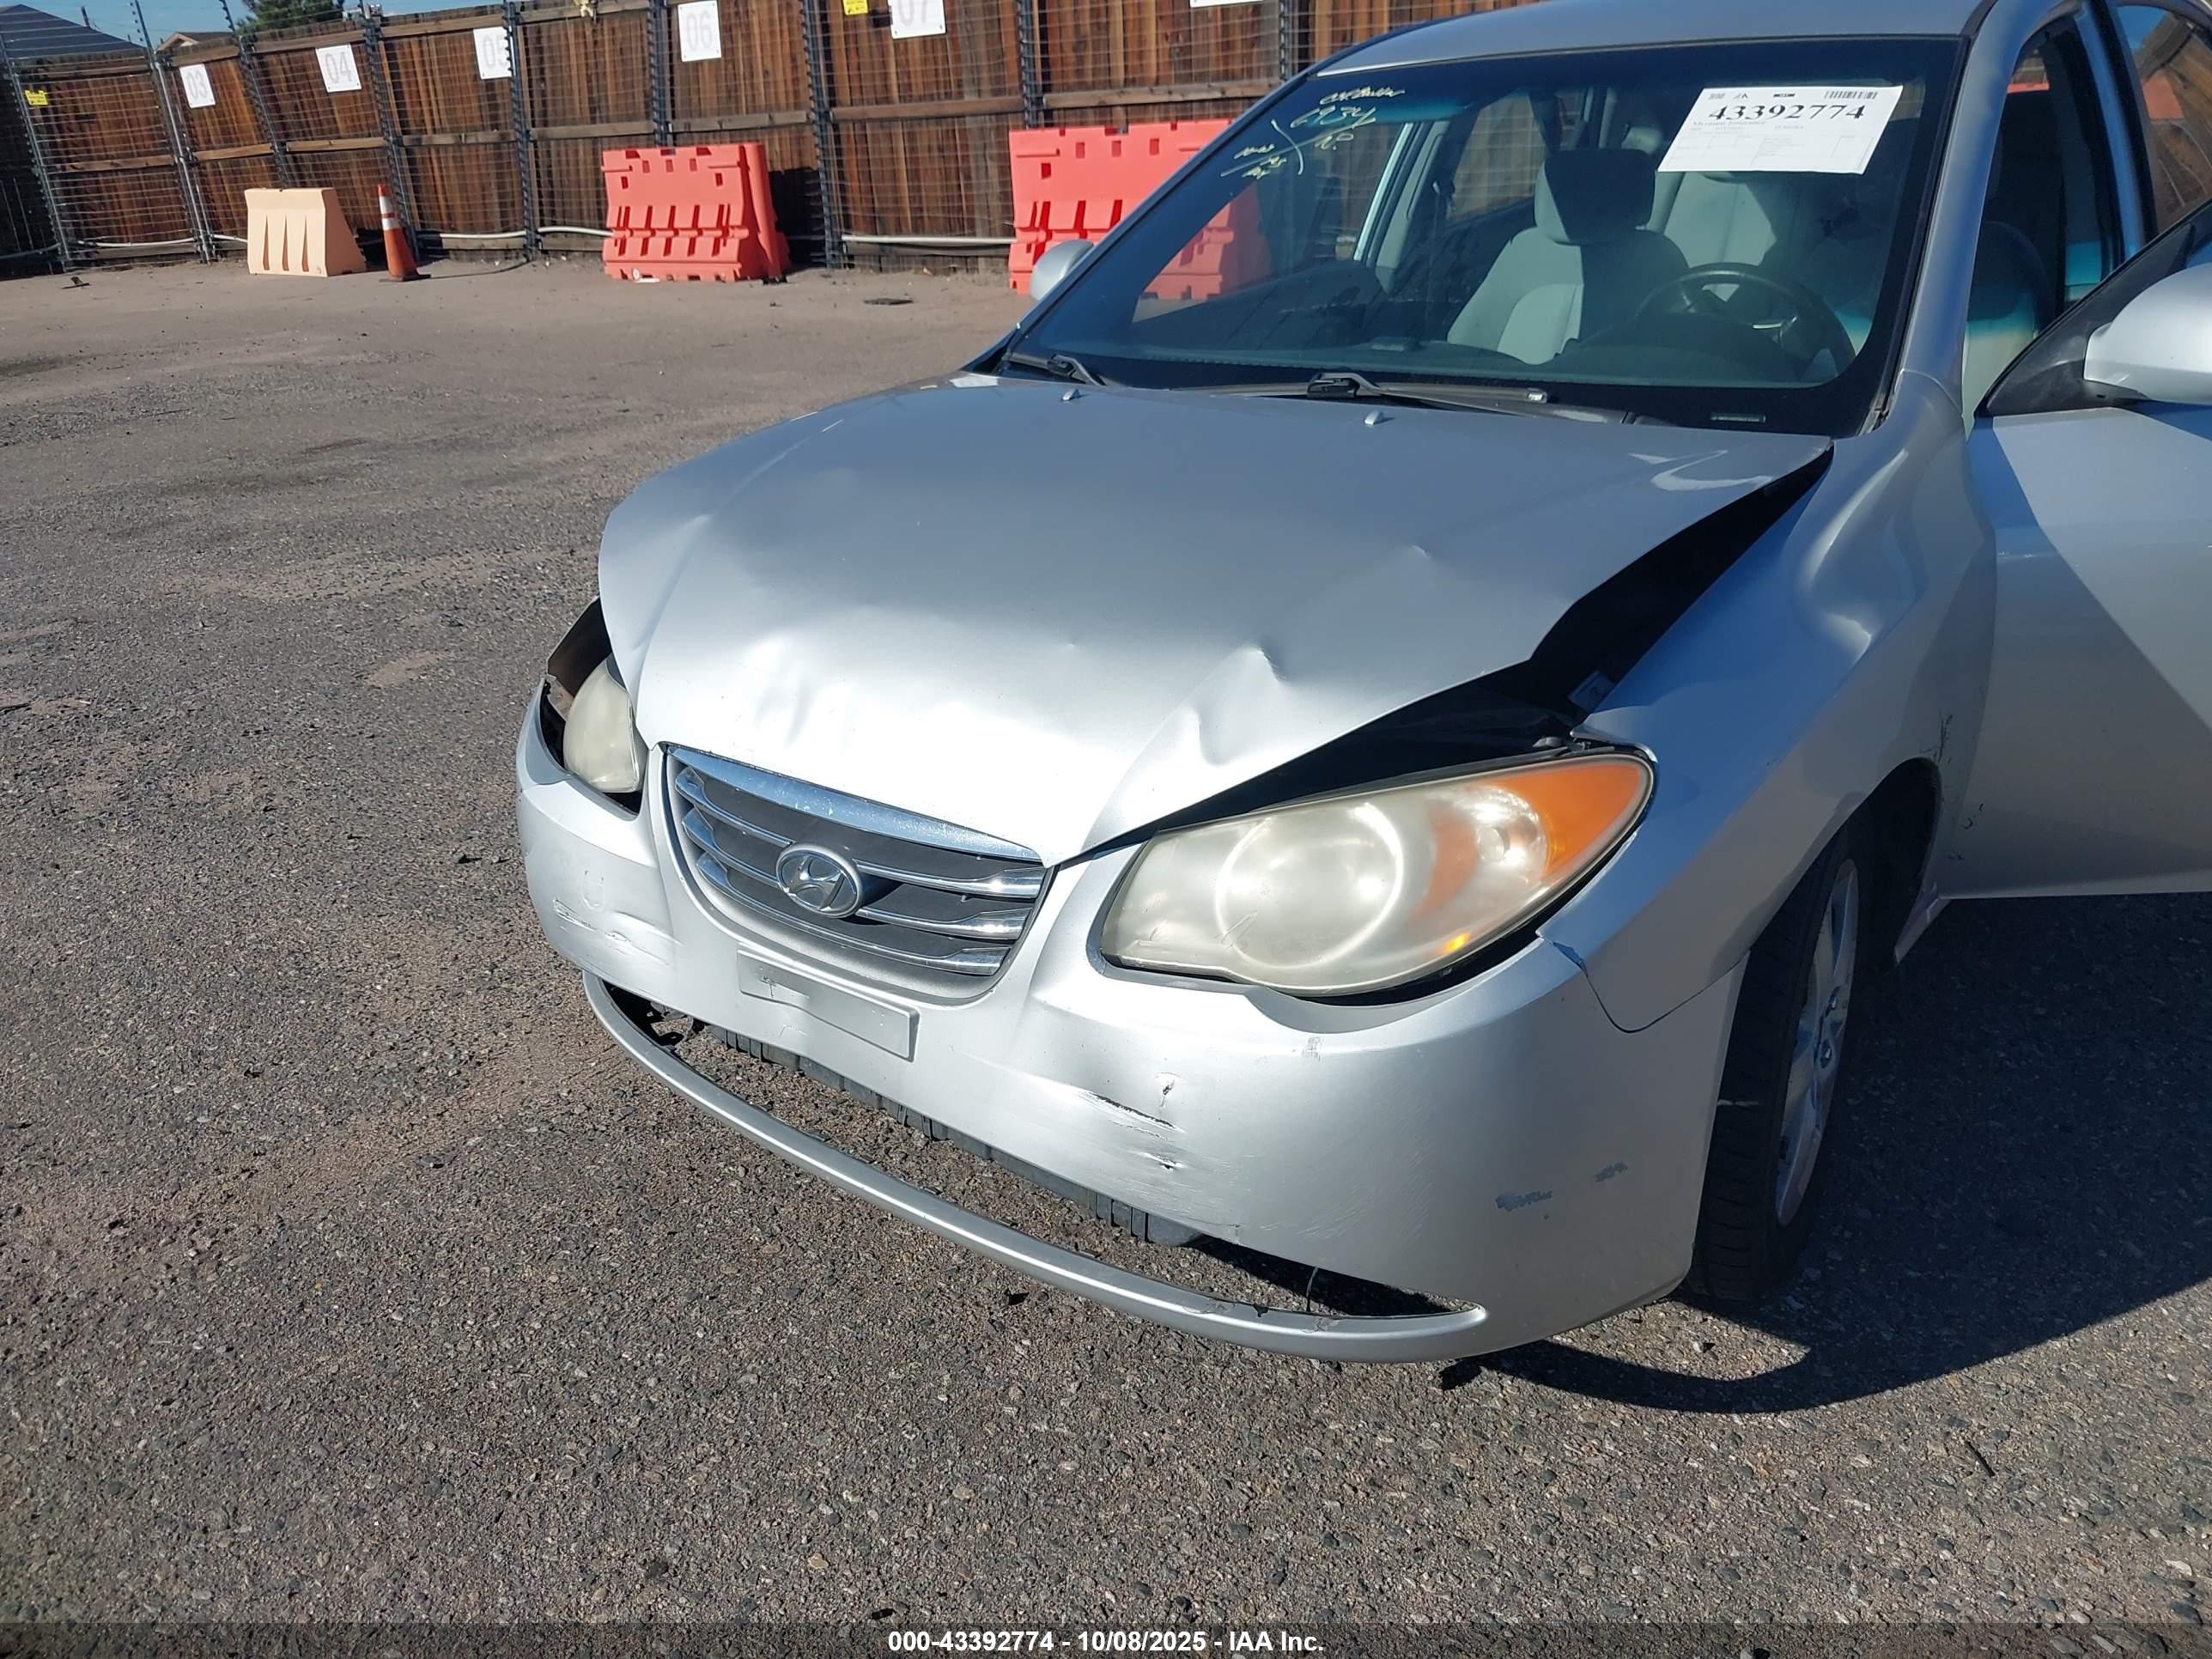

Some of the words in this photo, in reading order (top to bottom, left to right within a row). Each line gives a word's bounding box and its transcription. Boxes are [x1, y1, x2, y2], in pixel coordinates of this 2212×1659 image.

[686, 10, 713, 52] 06
[483, 33, 508, 69] 05
[325, 52, 352, 83] 04
[185, 70, 208, 100] 03
[1709, 104, 1865, 120] 43392774
